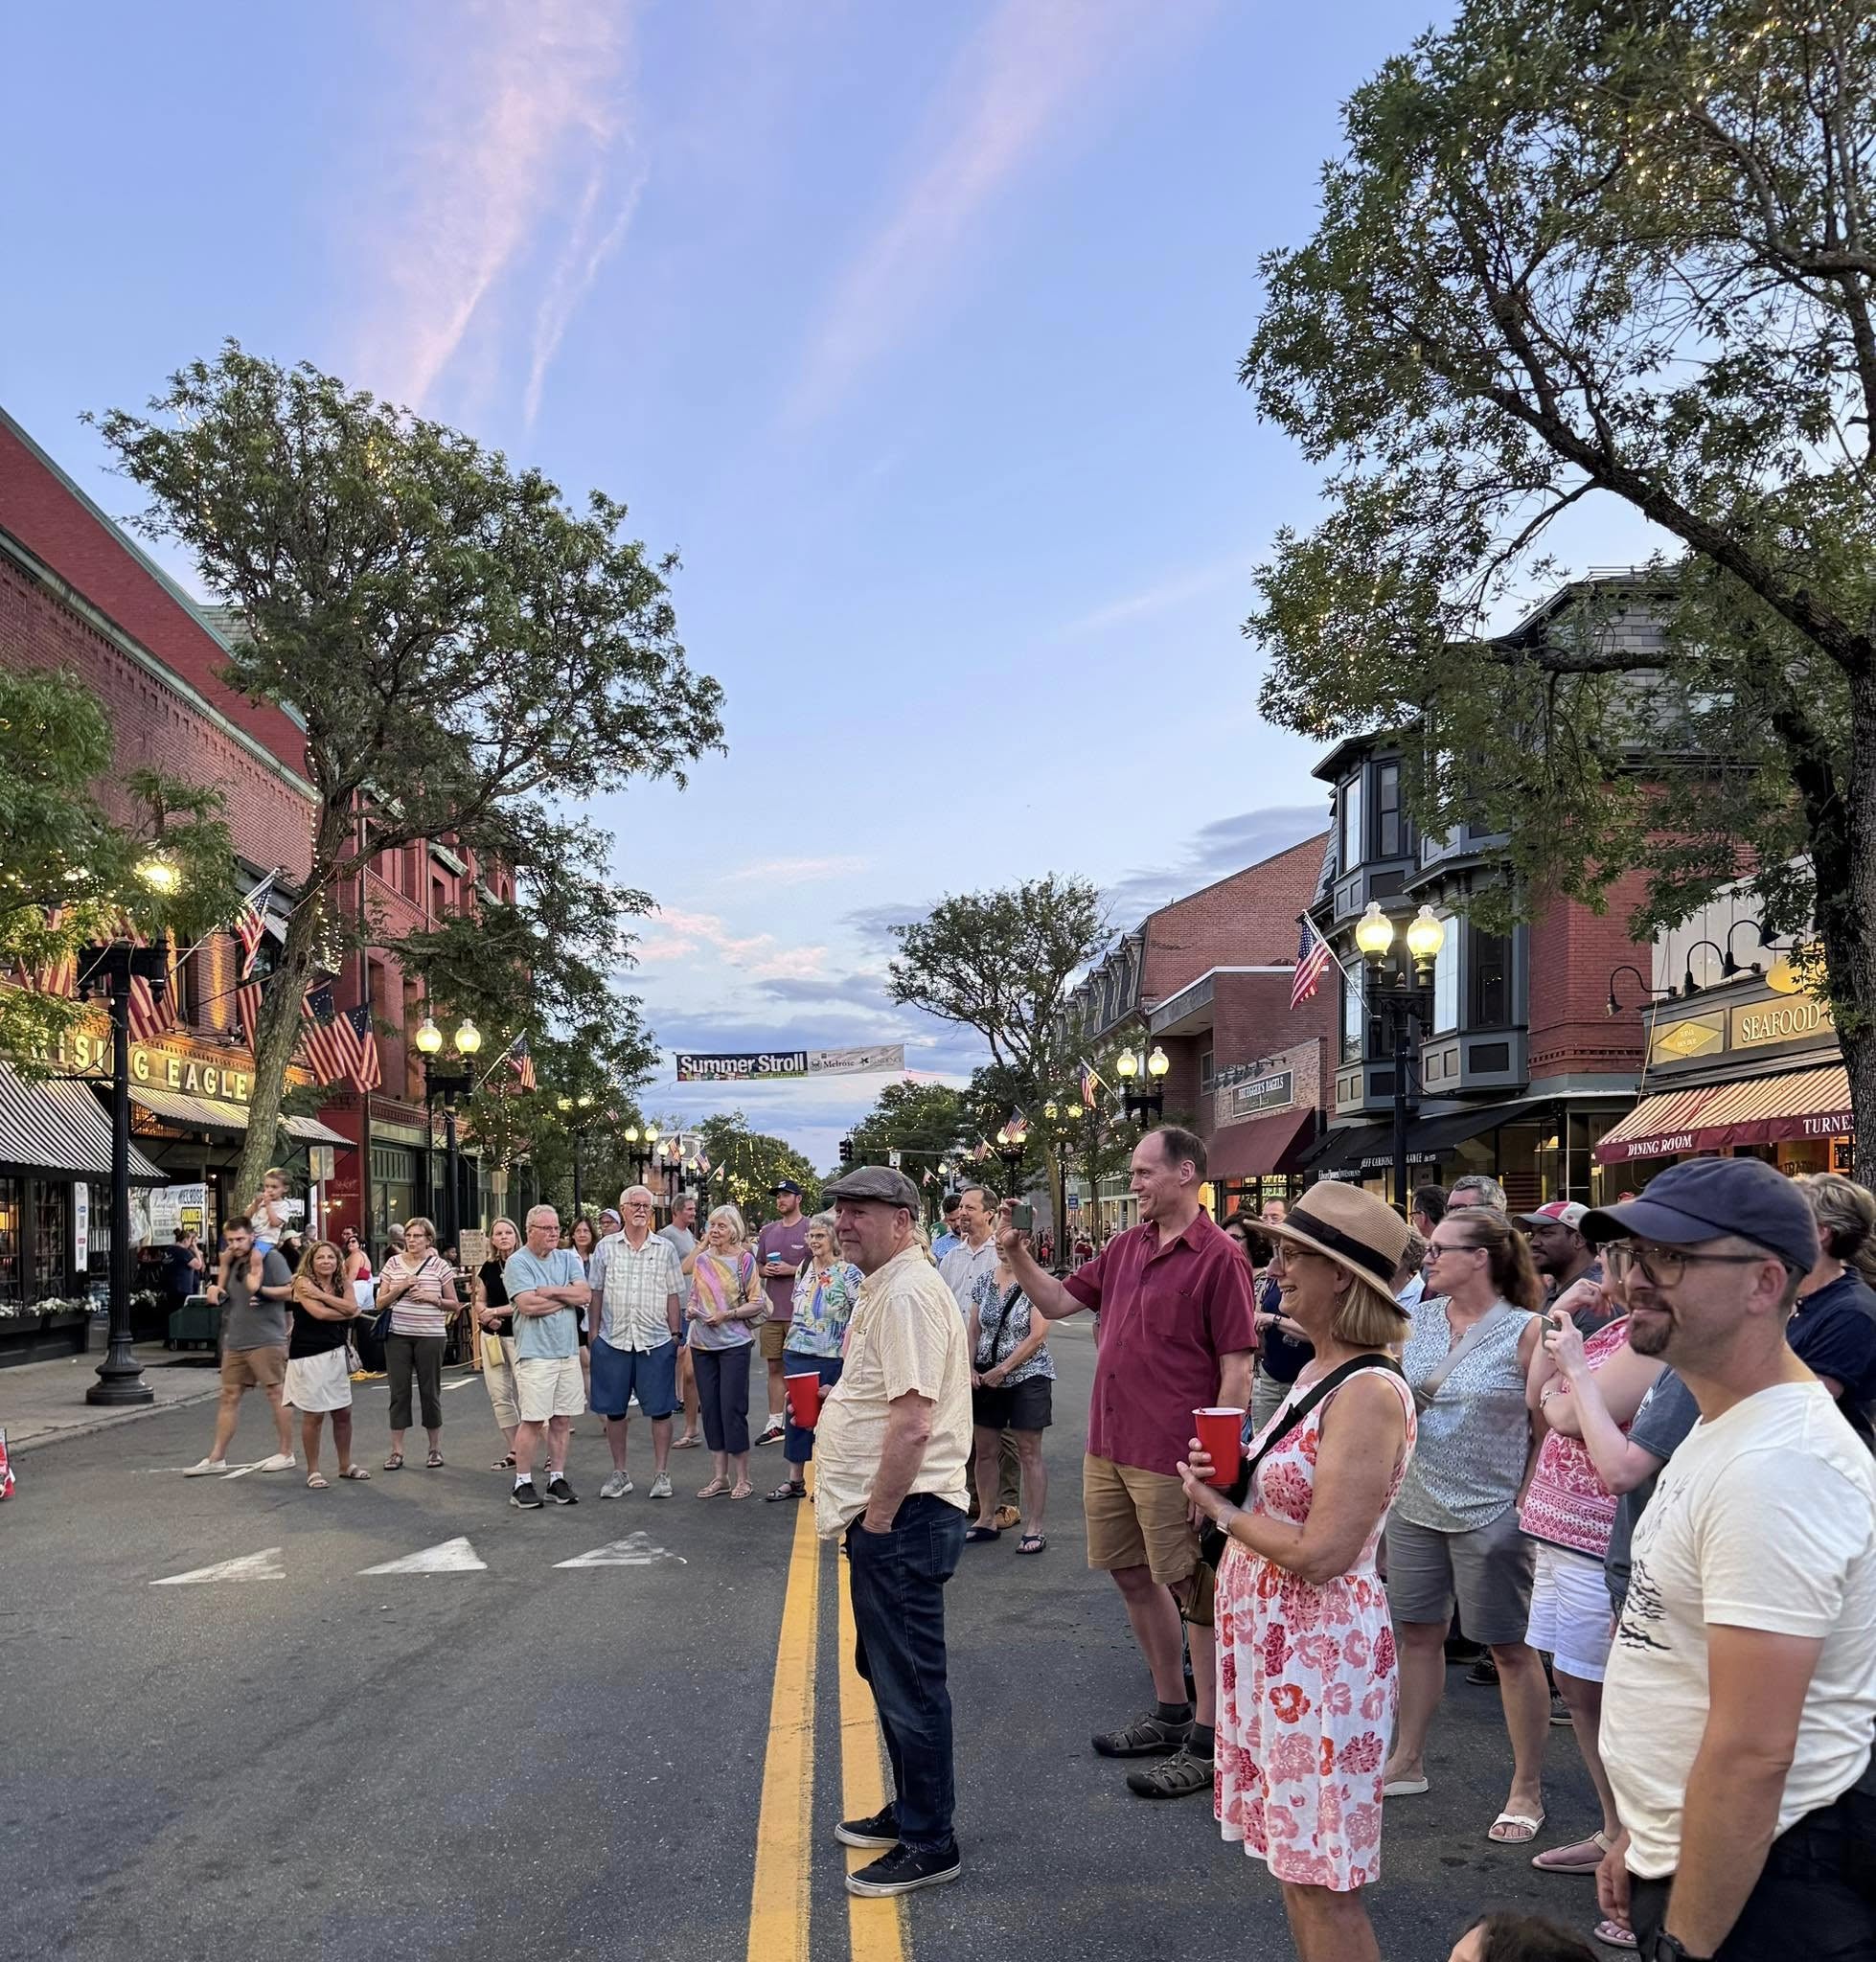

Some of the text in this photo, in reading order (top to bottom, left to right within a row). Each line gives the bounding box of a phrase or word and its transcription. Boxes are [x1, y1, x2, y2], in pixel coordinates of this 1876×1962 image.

[1742, 1003, 1820, 1042] SEAFOOD
[680, 1053, 805, 1073] Summer Stroll
[824, 1060, 855, 1068] Melrose
[167, 1058, 248, 1101] EAGLE
[1627, 1134, 1693, 1157] DINING ROOM
